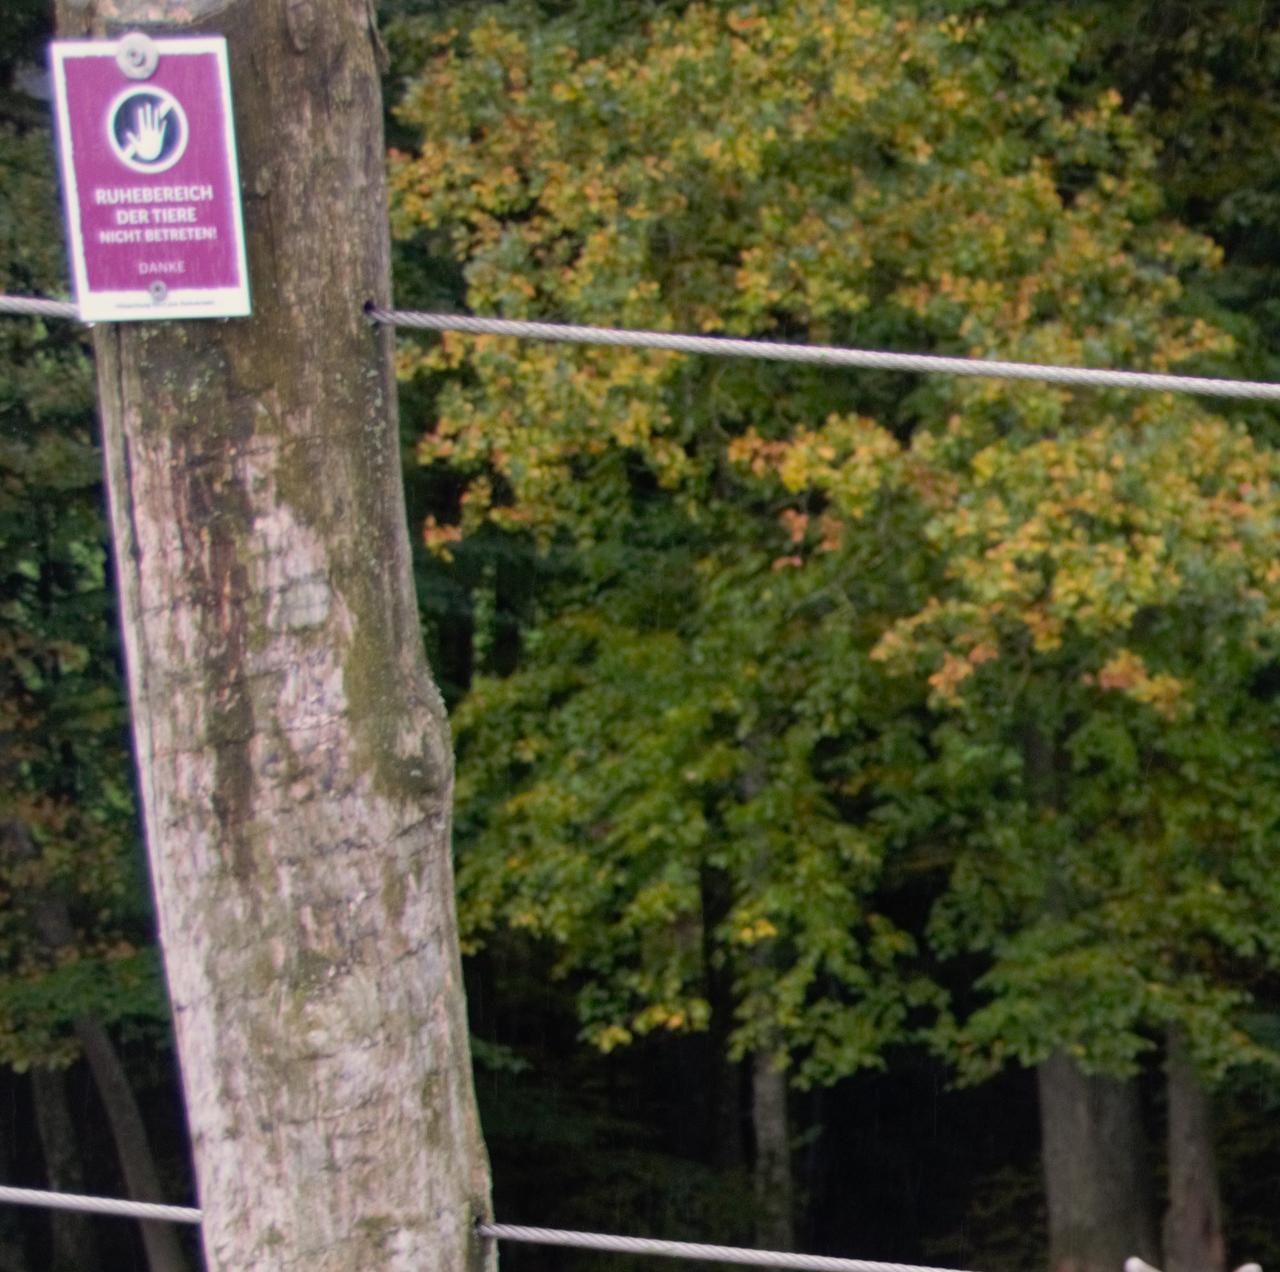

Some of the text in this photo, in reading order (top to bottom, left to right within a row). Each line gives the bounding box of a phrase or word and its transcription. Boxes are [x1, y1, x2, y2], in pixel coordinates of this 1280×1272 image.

[95, 185, 213, 205] RUHEBEREICH
[116, 207, 197, 224] DER TIERE
[99, 226, 216, 244] NICHT BETRETEN!
[138, 261, 185, 275] DANKE
